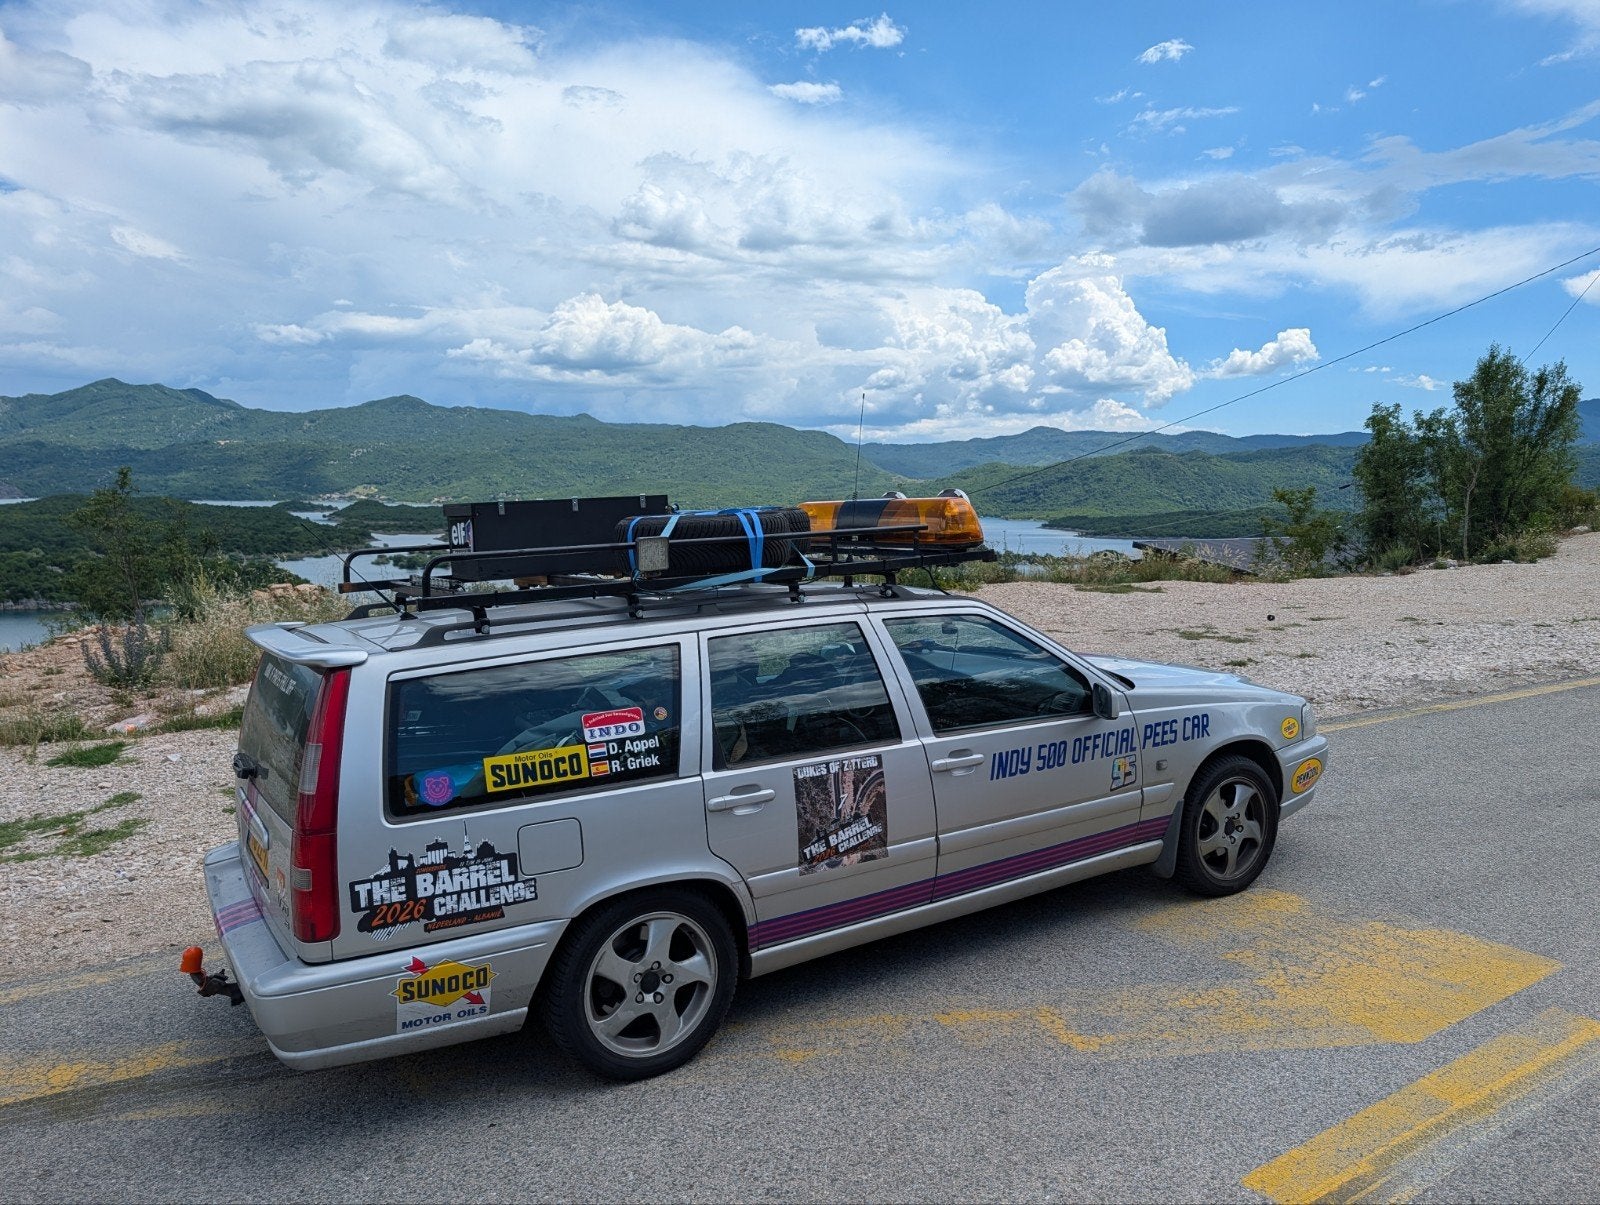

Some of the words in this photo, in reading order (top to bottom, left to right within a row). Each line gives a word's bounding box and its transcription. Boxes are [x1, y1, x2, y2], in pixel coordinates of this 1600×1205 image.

[451, 522, 466, 546] elf
[587, 722, 641, 740] INDO
[514, 753, 537, 763] Motor
[537, 751, 553, 762] Oils
[608, 742, 622, 755] D.
[624, 735, 660, 753] Appel
[990, 747, 1032, 781] INDY
[1036, 740, 1067, 771] 500
[1072, 727, 1137, 764] OFFICIAL
[1142, 718, 1178, 750] PEES
[1182, 713, 1211, 742] CAR
[490, 753, 583, 788] SUNOCO
[611, 760, 625, 773] R.
[627, 754, 661, 770] Griek
[829, 761, 841, 774] OF
[803, 839, 827, 860] THE
[828, 816, 873, 846] BARREL
[838, 823, 883, 853] CHALLENGE
[355, 877, 407, 909] THE
[415, 859, 516, 898] BARREL
[371, 899, 427, 928] 2026
[433, 880, 537, 916] CHALLENGE
[401, 966, 488, 1002] SUNOCO
[401, 1013, 452, 1030] MOTOR
[456, 1006, 488, 1019] OILS
